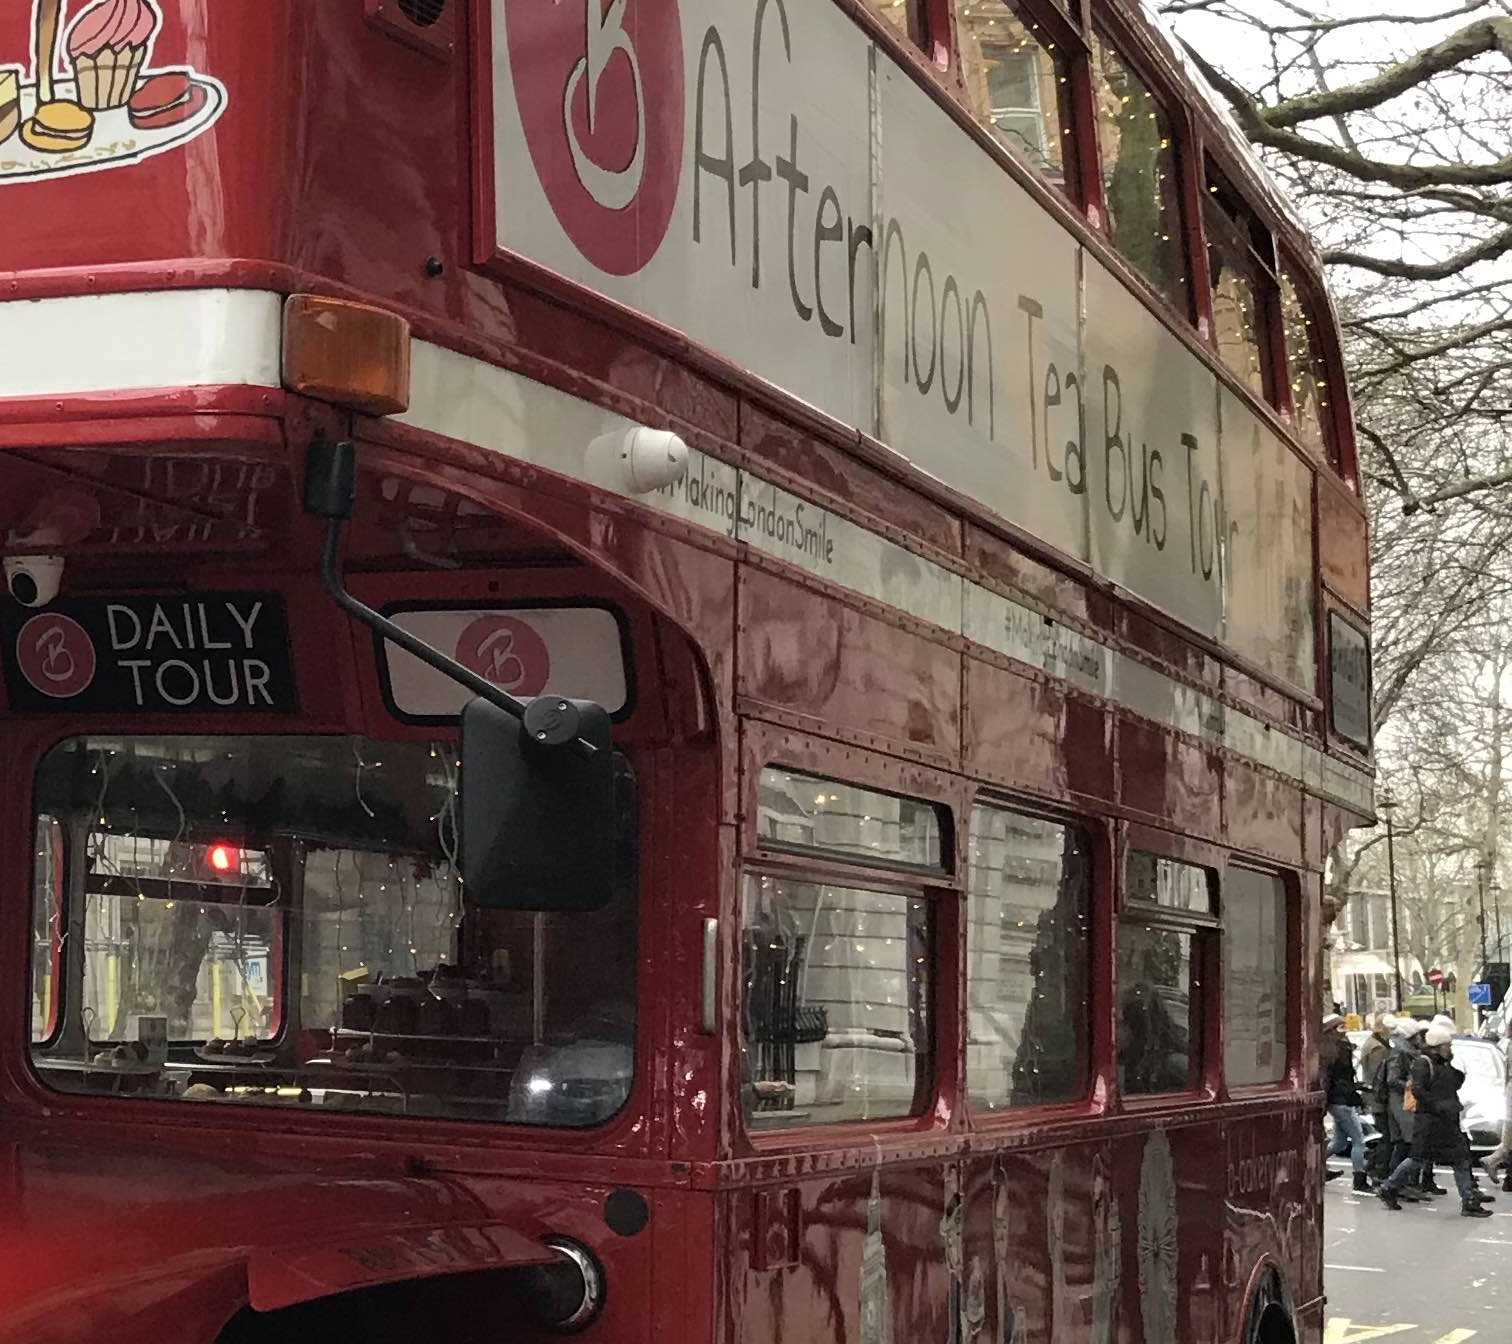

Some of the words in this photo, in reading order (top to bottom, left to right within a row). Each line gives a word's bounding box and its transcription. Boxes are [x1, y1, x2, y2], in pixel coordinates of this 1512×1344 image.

[1017, 293, 1086, 495] Tea
[1102, 364, 1168, 552] Bus
[107, 601, 264, 651] DAILY
[117, 659, 275, 708] TOUR
